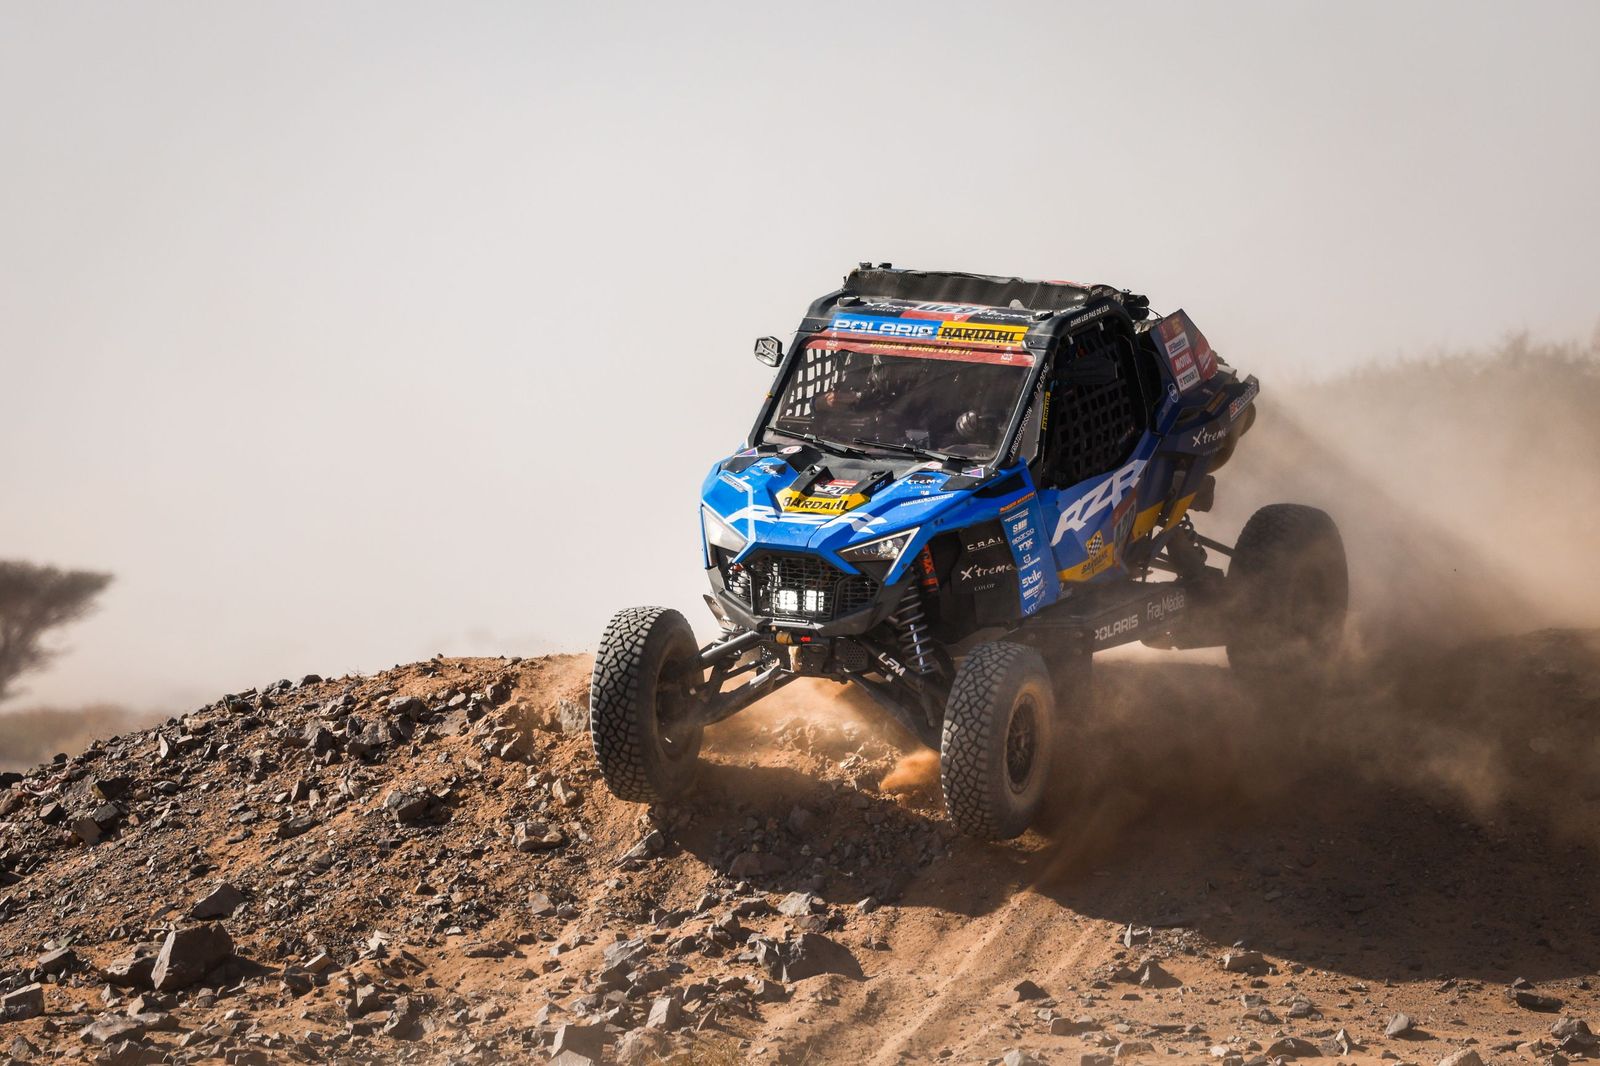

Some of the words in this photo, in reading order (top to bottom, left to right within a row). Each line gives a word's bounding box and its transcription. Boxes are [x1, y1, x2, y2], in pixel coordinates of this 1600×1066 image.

[833, 319, 934, 338] POLARIS
[941, 327, 1017, 344] BARDAHL
[1050, 459, 1149, 547] RZR
[1021, 570, 1042, 588] Stilo
[878, 652, 905, 676] LFM
